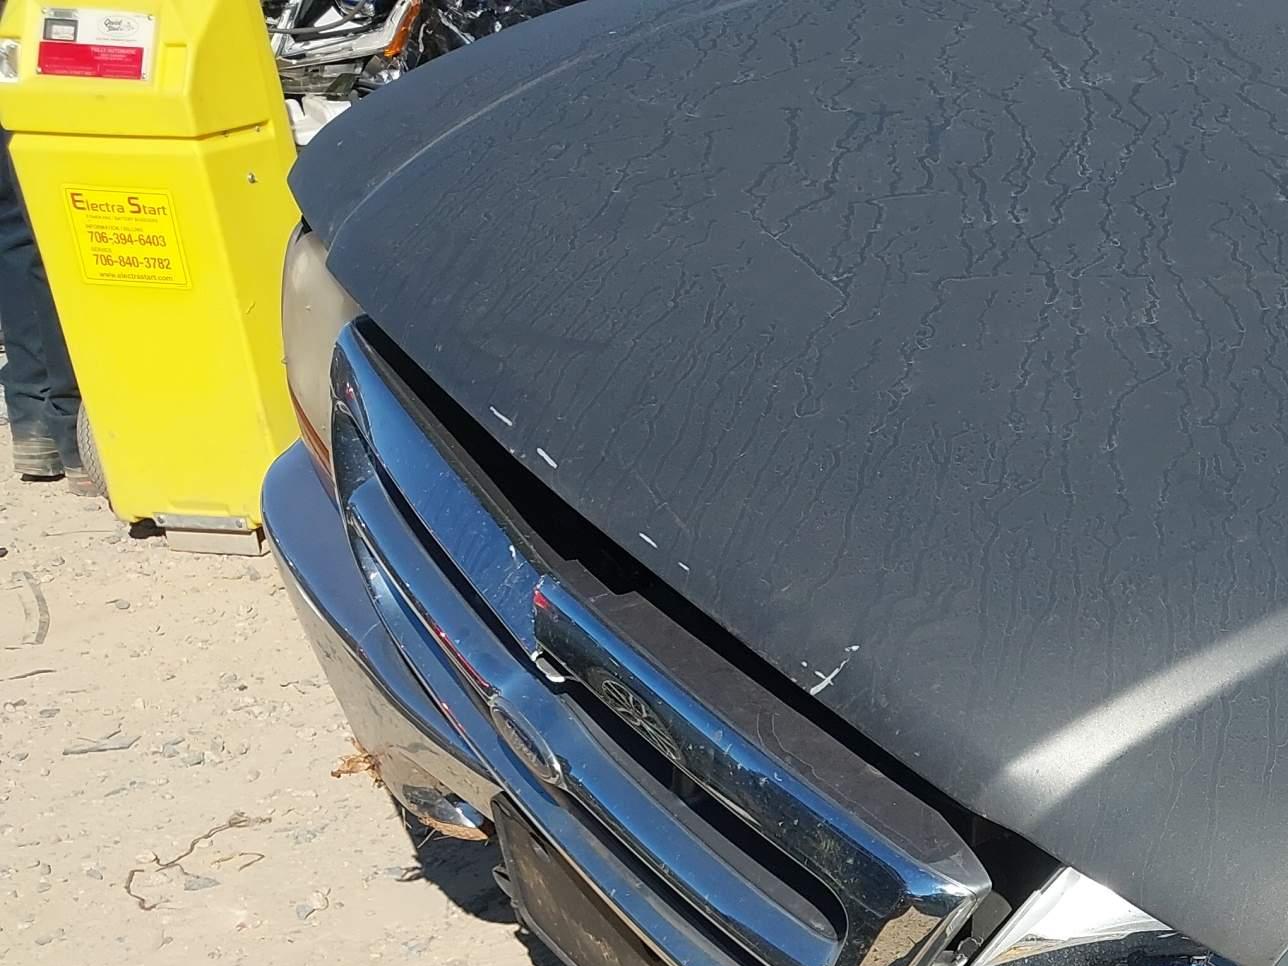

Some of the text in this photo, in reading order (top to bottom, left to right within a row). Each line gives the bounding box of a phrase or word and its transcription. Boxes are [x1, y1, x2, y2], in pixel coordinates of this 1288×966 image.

[70, 192, 168, 215] Electra Start
[88, 231, 166, 247] 706-394-6403
[92, 254, 172, 269] 706-840-3782
